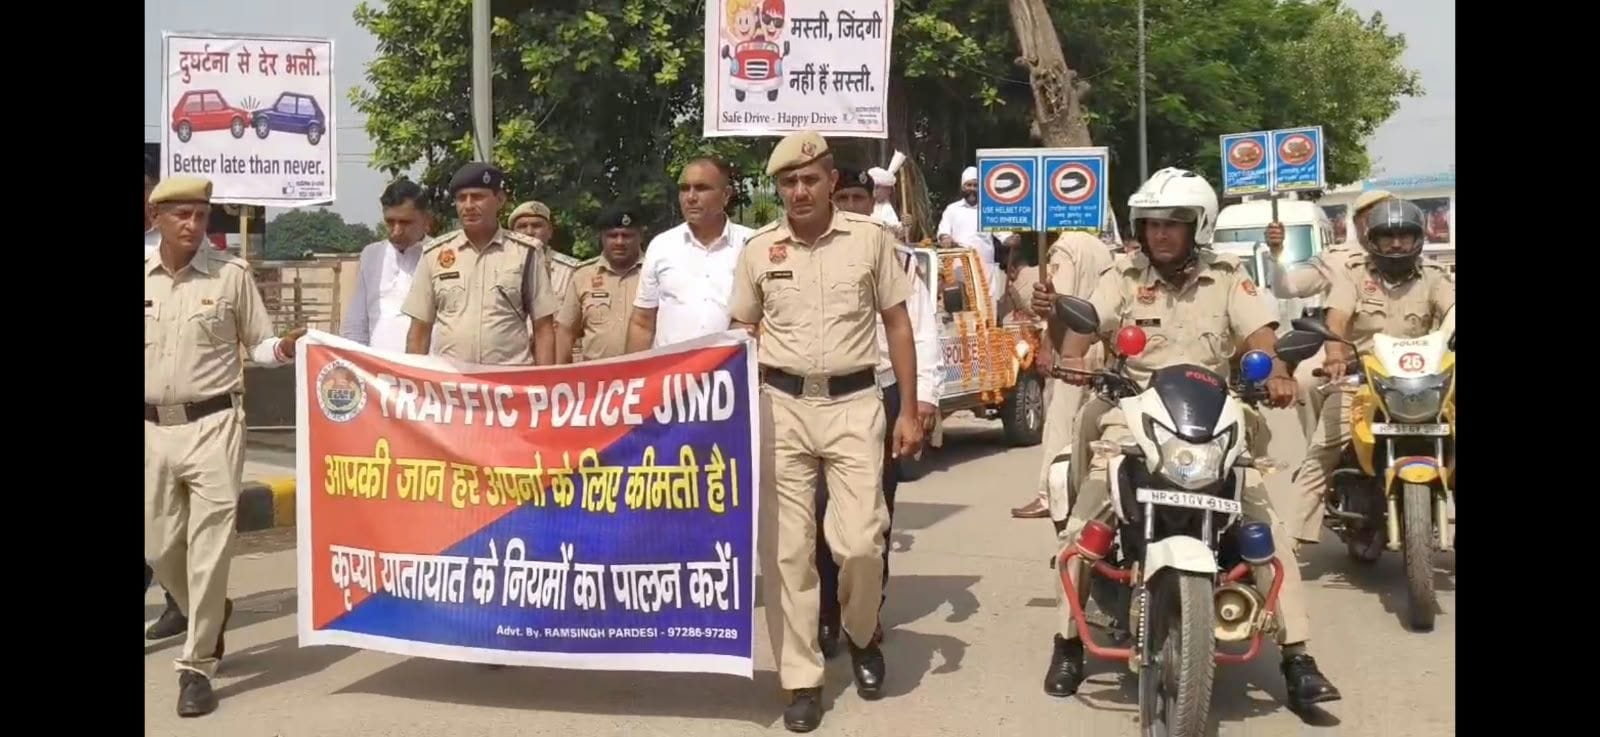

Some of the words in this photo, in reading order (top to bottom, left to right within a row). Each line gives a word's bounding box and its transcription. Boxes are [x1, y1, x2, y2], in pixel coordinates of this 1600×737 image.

[790, 10, 832, 41] मस्ती,
[837, 10, 882, 40] जिंदगी
[237, 46, 250, 74] से
[259, 47, 278, 76] देर
[285, 48, 320, 76] भली.
[789, 63, 814, 95] नहीं
[832, 64, 874, 92] सस्ती.
[722, 111, 742, 123] Safe
[744, 112, 770, 124] Drive
[777, 112, 809, 127] Happy
[811, 112, 837, 124] Drive
[173, 153, 217, 173] Better
[220, 153, 246, 174] late
[250, 155, 280, 174] than
[284, 158, 325, 175] never.
[982, 206, 994, 214] USE
[995, 206, 1018, 214] HELMET
[986, 216, 999, 224] TWO
[377, 373, 519, 428] TRAFFIC
[527, 377, 646, 428] POLICE
[653, 369, 735, 424] JIND
[324, 438, 391, 499] आपकी
[396, 458, 447, 502] जान
[451, 462, 480, 508] हर
[547, 451, 575, 507] के
[579, 447, 624, 513] लिए
[625, 445, 699, 510] कीमती
[379, 553, 468, 604] यातायात
[472, 538, 499, 605] के
[502, 537, 573, 611] नियमों
[574, 563, 606, 611] का
[610, 563, 682, 613] पालन
[496, 625, 523, 637] Advt.
[544, 627, 605, 639] RAMSINGH
[608, 628, 658, 638] PARDESI
[668, 627, 738, 640] 97286-97289
